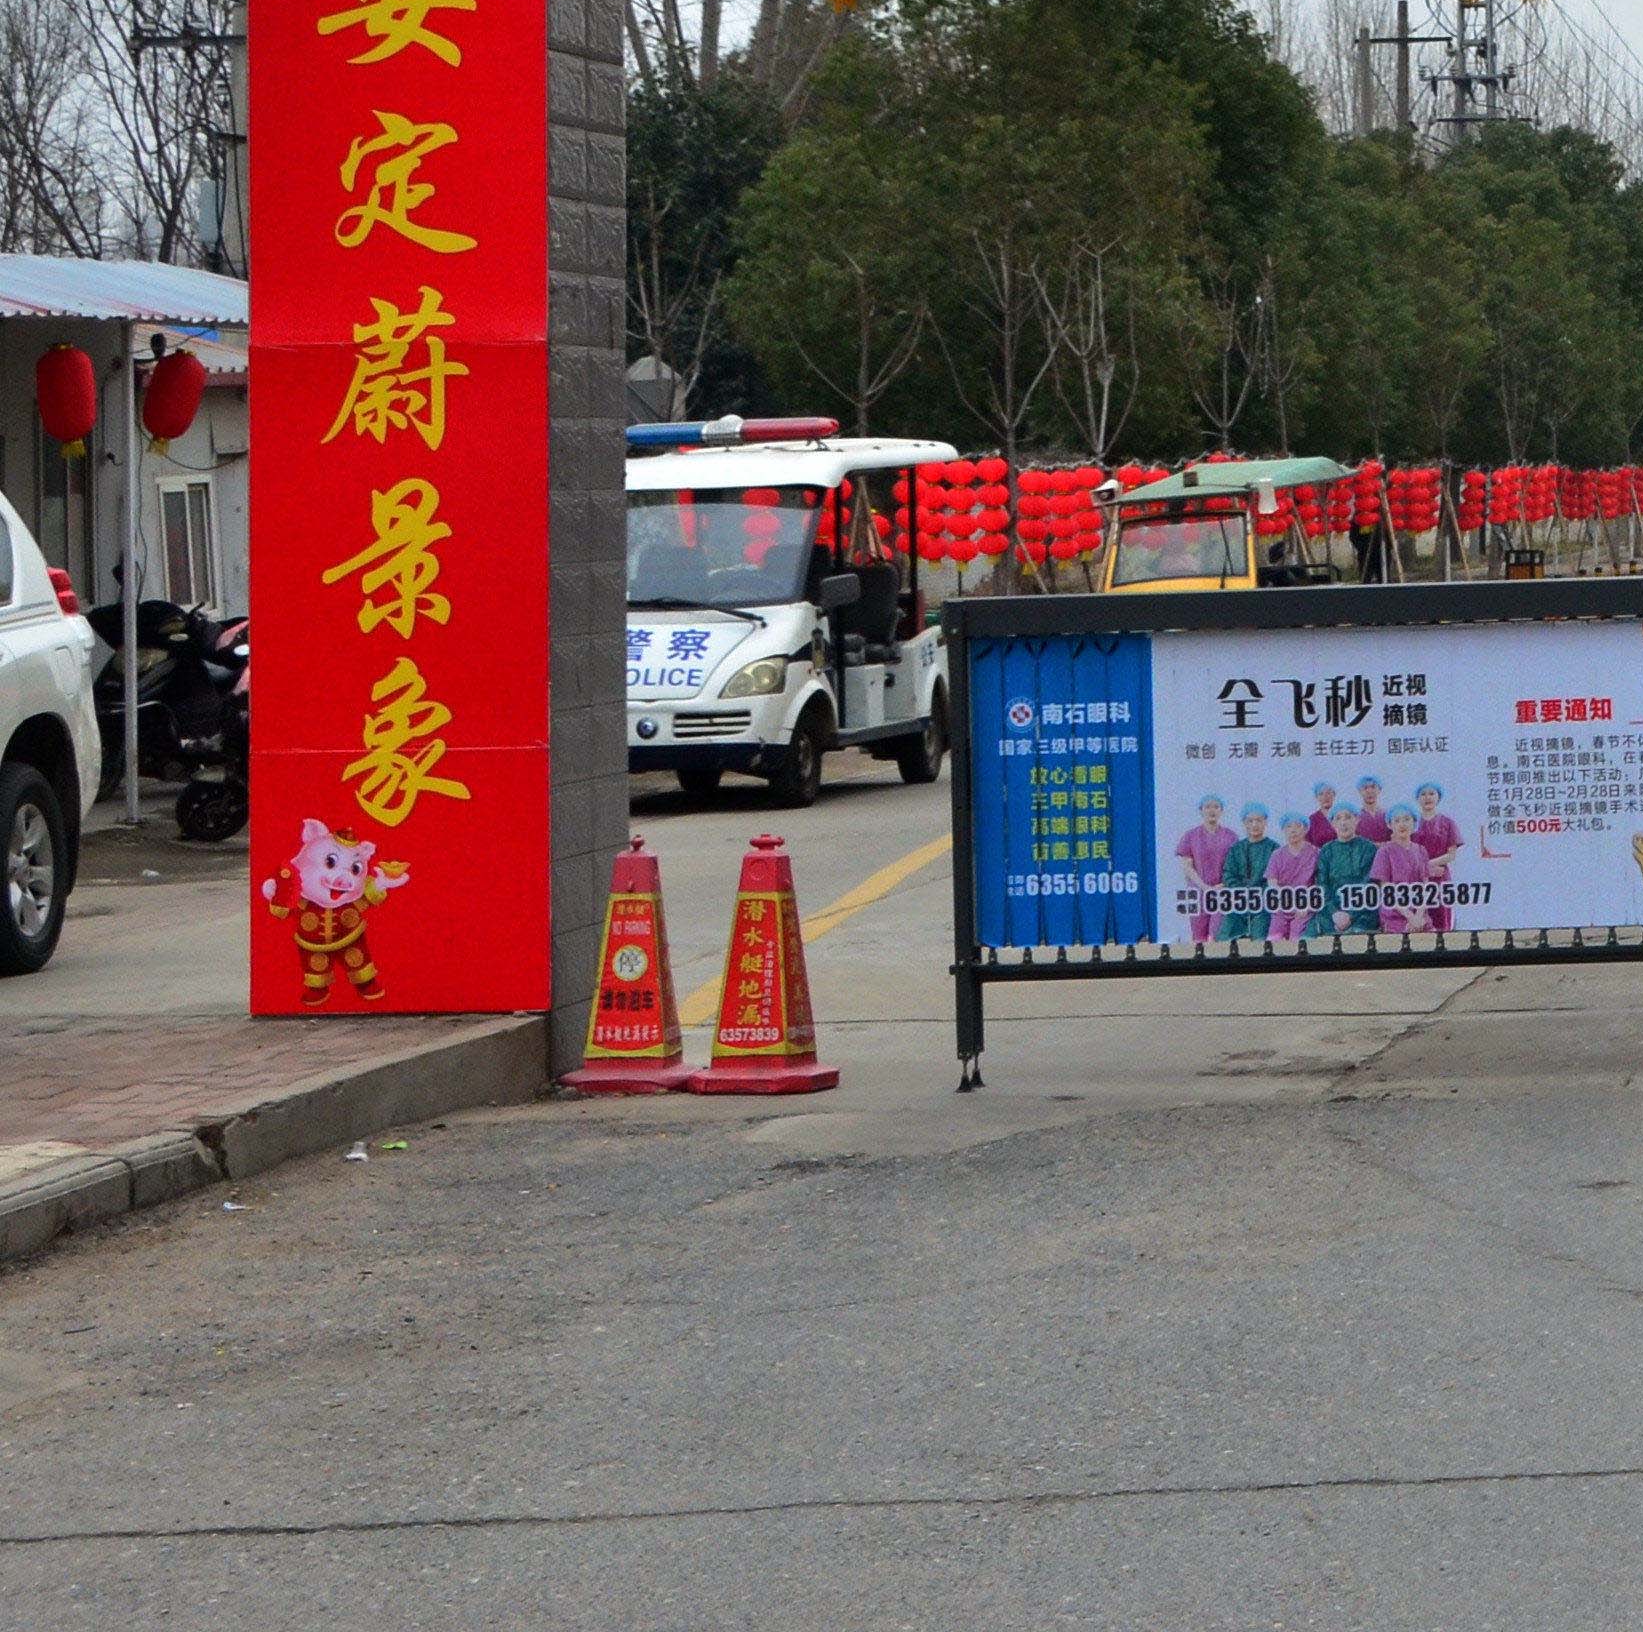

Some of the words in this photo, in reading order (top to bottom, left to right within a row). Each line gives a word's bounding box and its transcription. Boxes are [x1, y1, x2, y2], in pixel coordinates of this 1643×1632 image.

[626, 667, 704, 687] OLICE
[1382, 674, 1427, 697] 近视
[1042, 701, 1131, 725] 南石眼科
[1216, 674, 1374, 729] 全飞秒
[1514, 697, 1614, 724] 重要通知
[1382, 703, 1428, 727] 摘镜
[1186, 743, 1217, 760] 微创
[1271, 741, 1302, 758] 无痛
[1314, 739, 1376, 756] 主任主刀
[1387, 736, 1450, 755] 国际认证
[1025, 873, 1080, 897] 6355
[1083, 871, 1139, 895] 6066
[1205, 889, 1262, 913] 6355
[1265, 886, 1324, 911] 6066
[1340, 885, 1379, 909] 150
[1382, 883, 1439, 908] 8332
[1441, 881, 1492, 906] 5877
